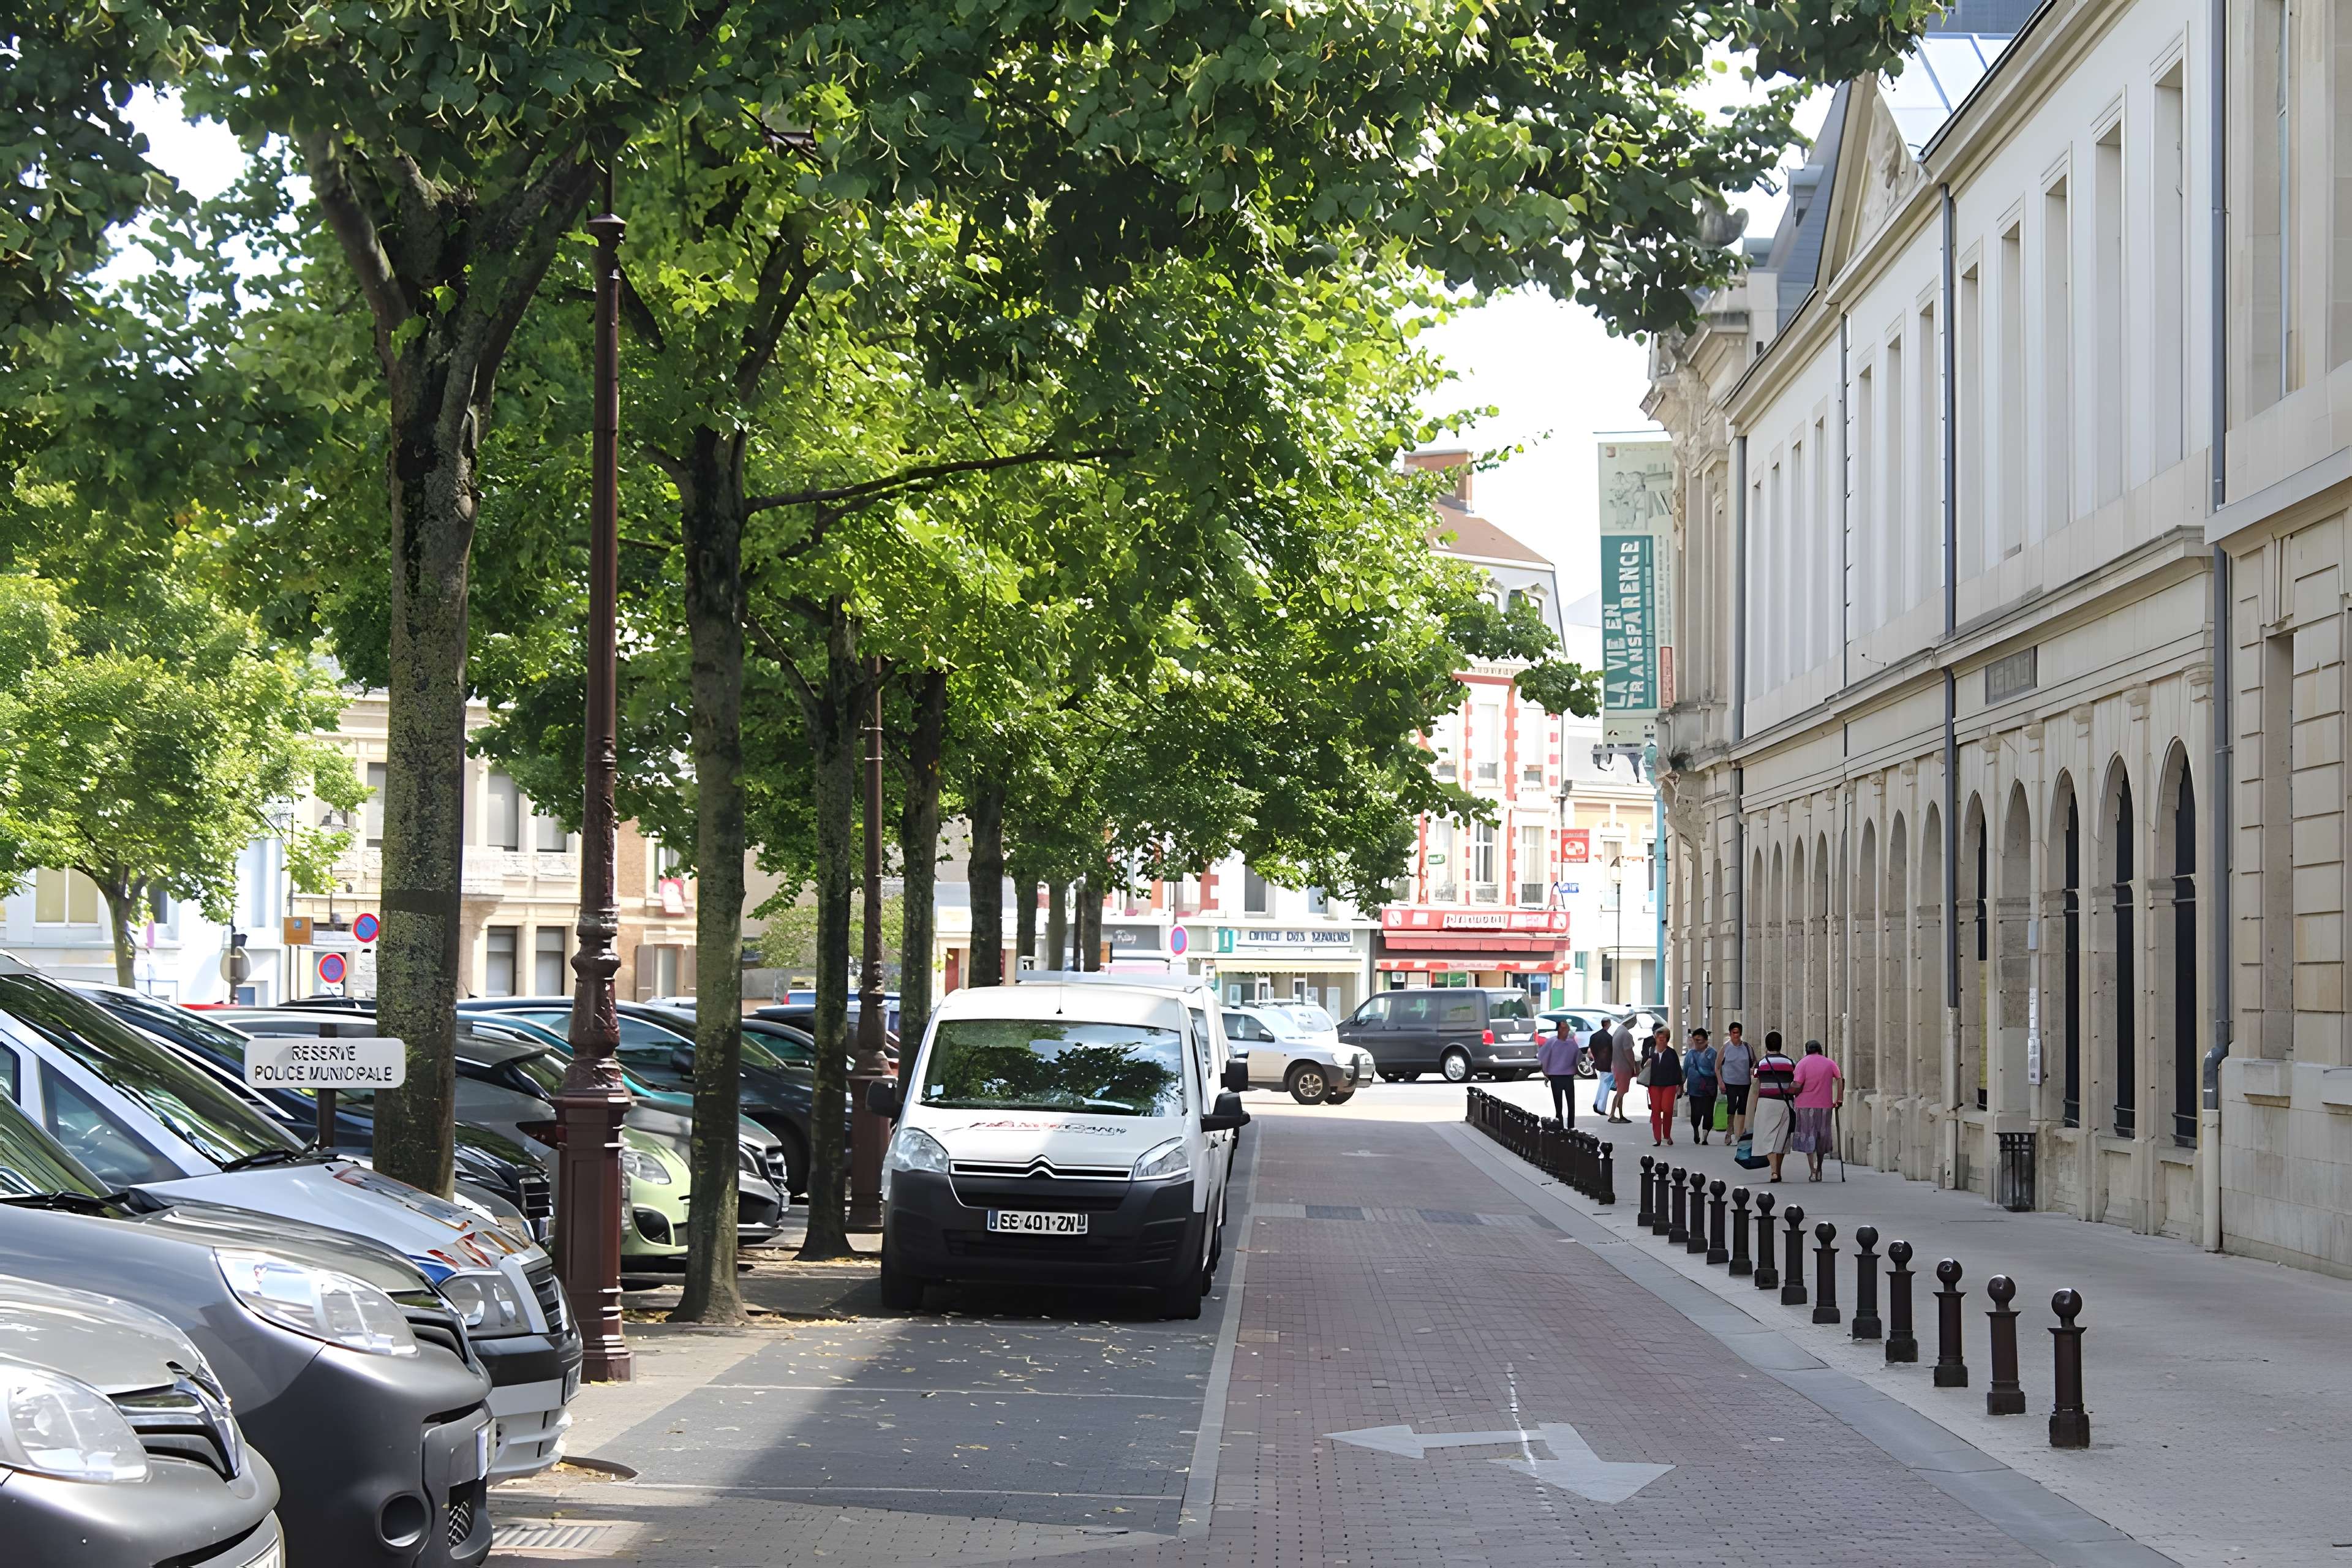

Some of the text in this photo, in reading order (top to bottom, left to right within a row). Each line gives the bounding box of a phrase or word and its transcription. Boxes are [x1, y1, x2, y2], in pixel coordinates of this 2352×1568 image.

[1604, 604, 1628, 708] LA VIE EN
[1619, 540, 1645, 709] TRANSPARENCE
[255, 1065, 305, 1080] POLICE
